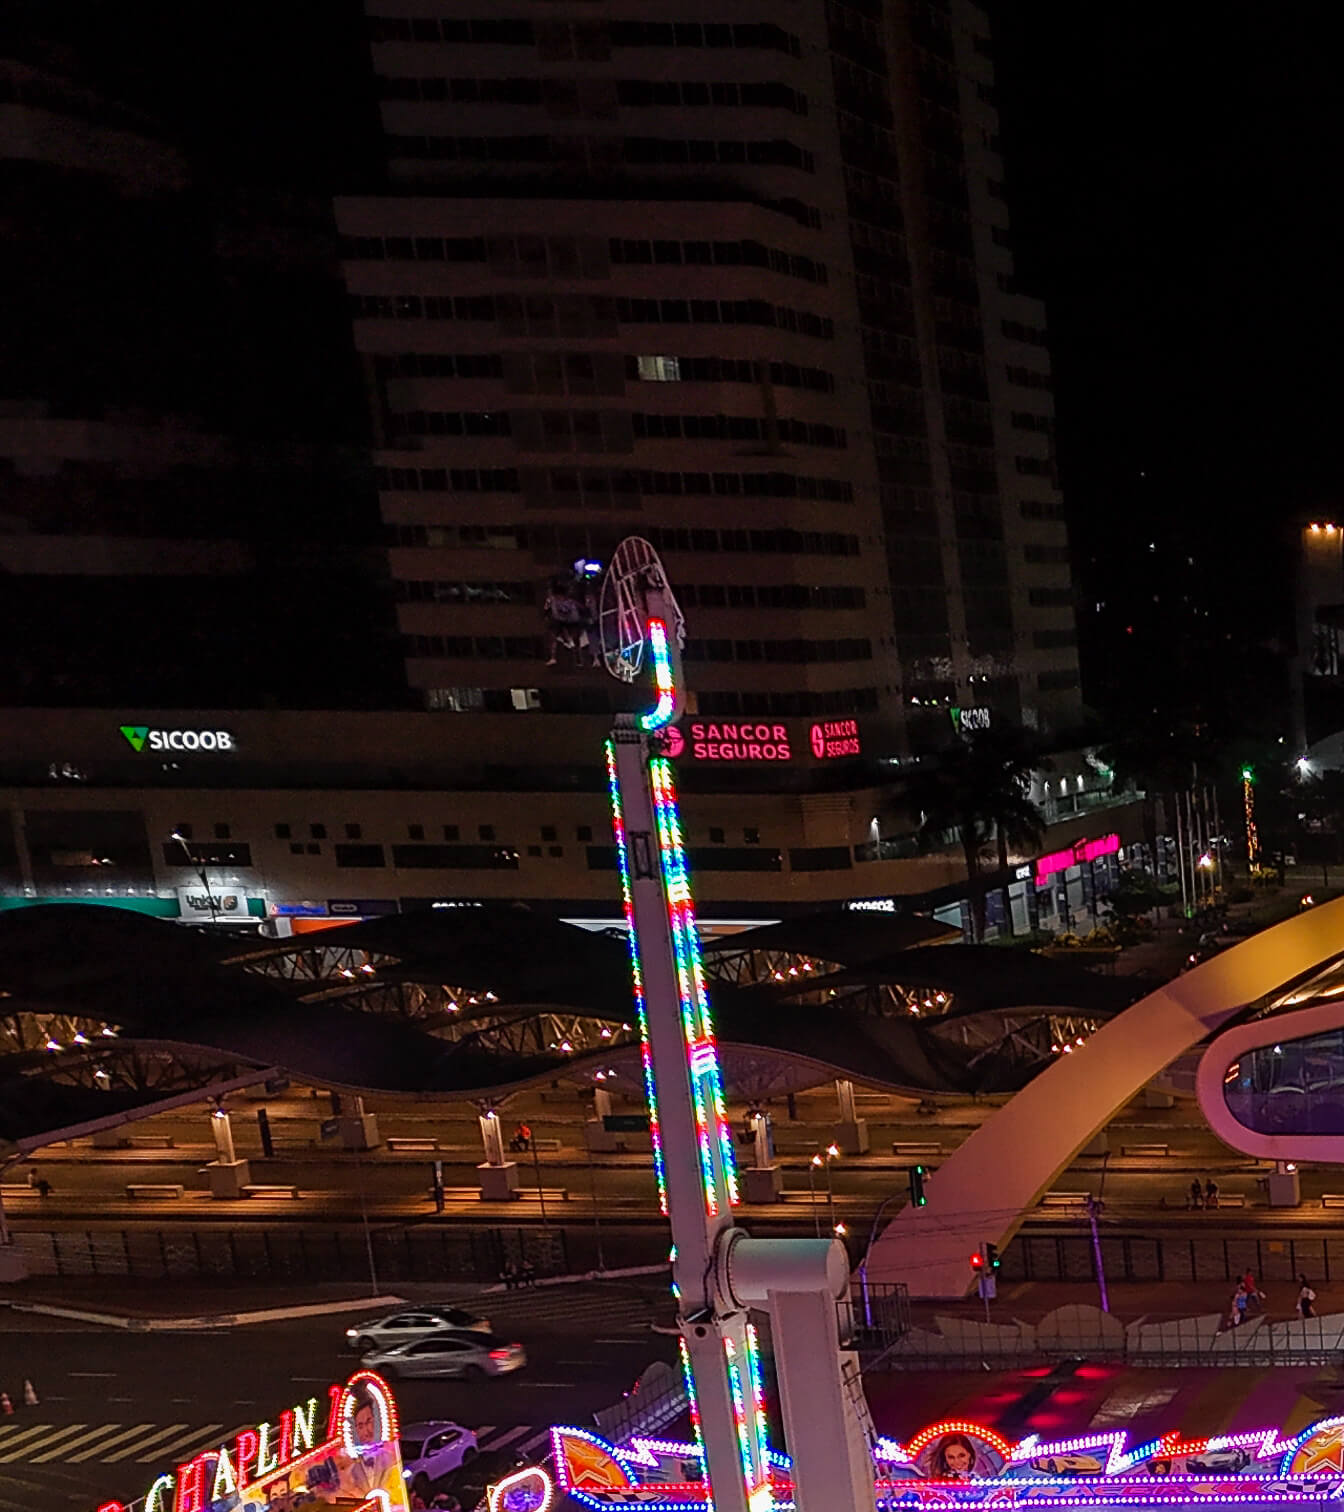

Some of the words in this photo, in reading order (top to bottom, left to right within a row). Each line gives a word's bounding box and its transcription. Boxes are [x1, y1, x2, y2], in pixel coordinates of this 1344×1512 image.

[691, 724, 788, 741] SANCOR
[824, 720, 857, 738] SANCOR
[149, 731, 233, 749] SICOOB
[827, 738, 859, 757] SEGUROS
[694, 743, 790, 760] SEGUROS
